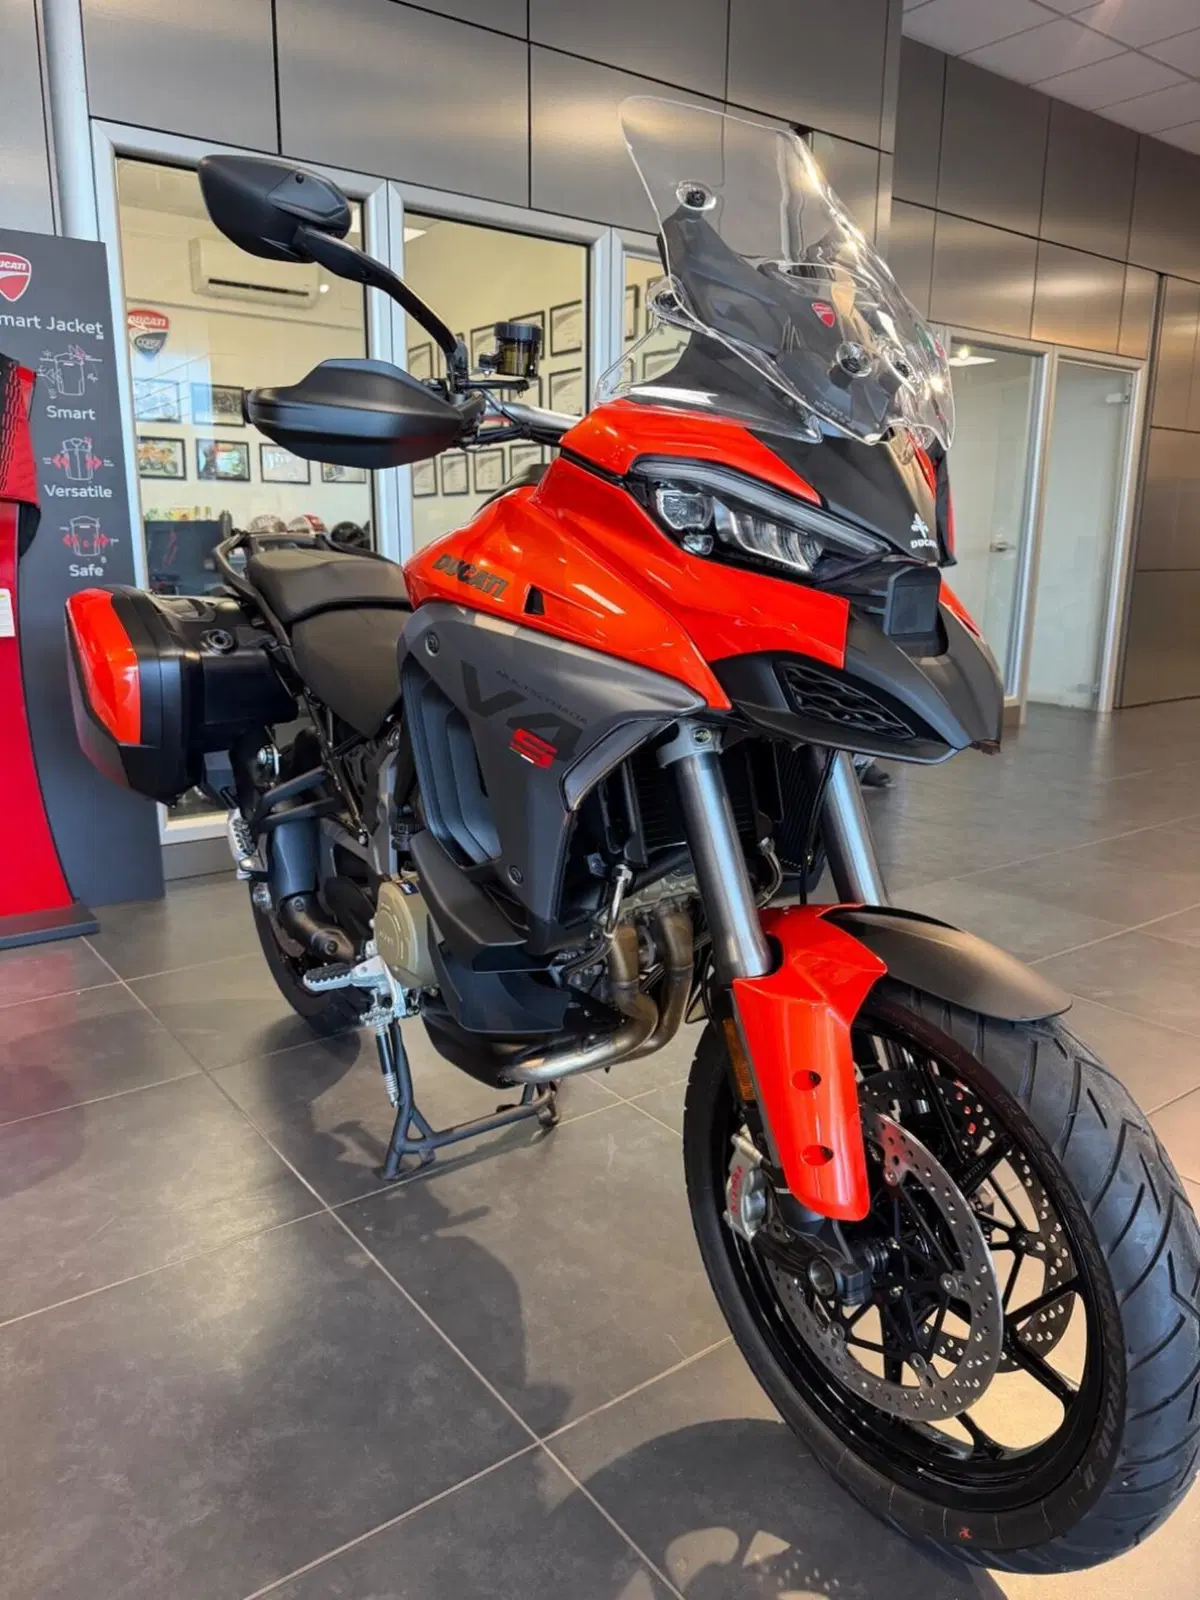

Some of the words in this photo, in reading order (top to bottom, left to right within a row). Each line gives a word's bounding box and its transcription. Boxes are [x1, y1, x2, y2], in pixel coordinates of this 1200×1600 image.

[0, 260, 26, 271] UCATI
[0, 315, 41, 329] mart
[46, 316, 103, 335] Jacket
[46, 405, 96, 421] Smart
[44, 484, 113, 498] Versatile
[69, 564, 104, 577] Safe
[432, 553, 509, 598] DUCATI
